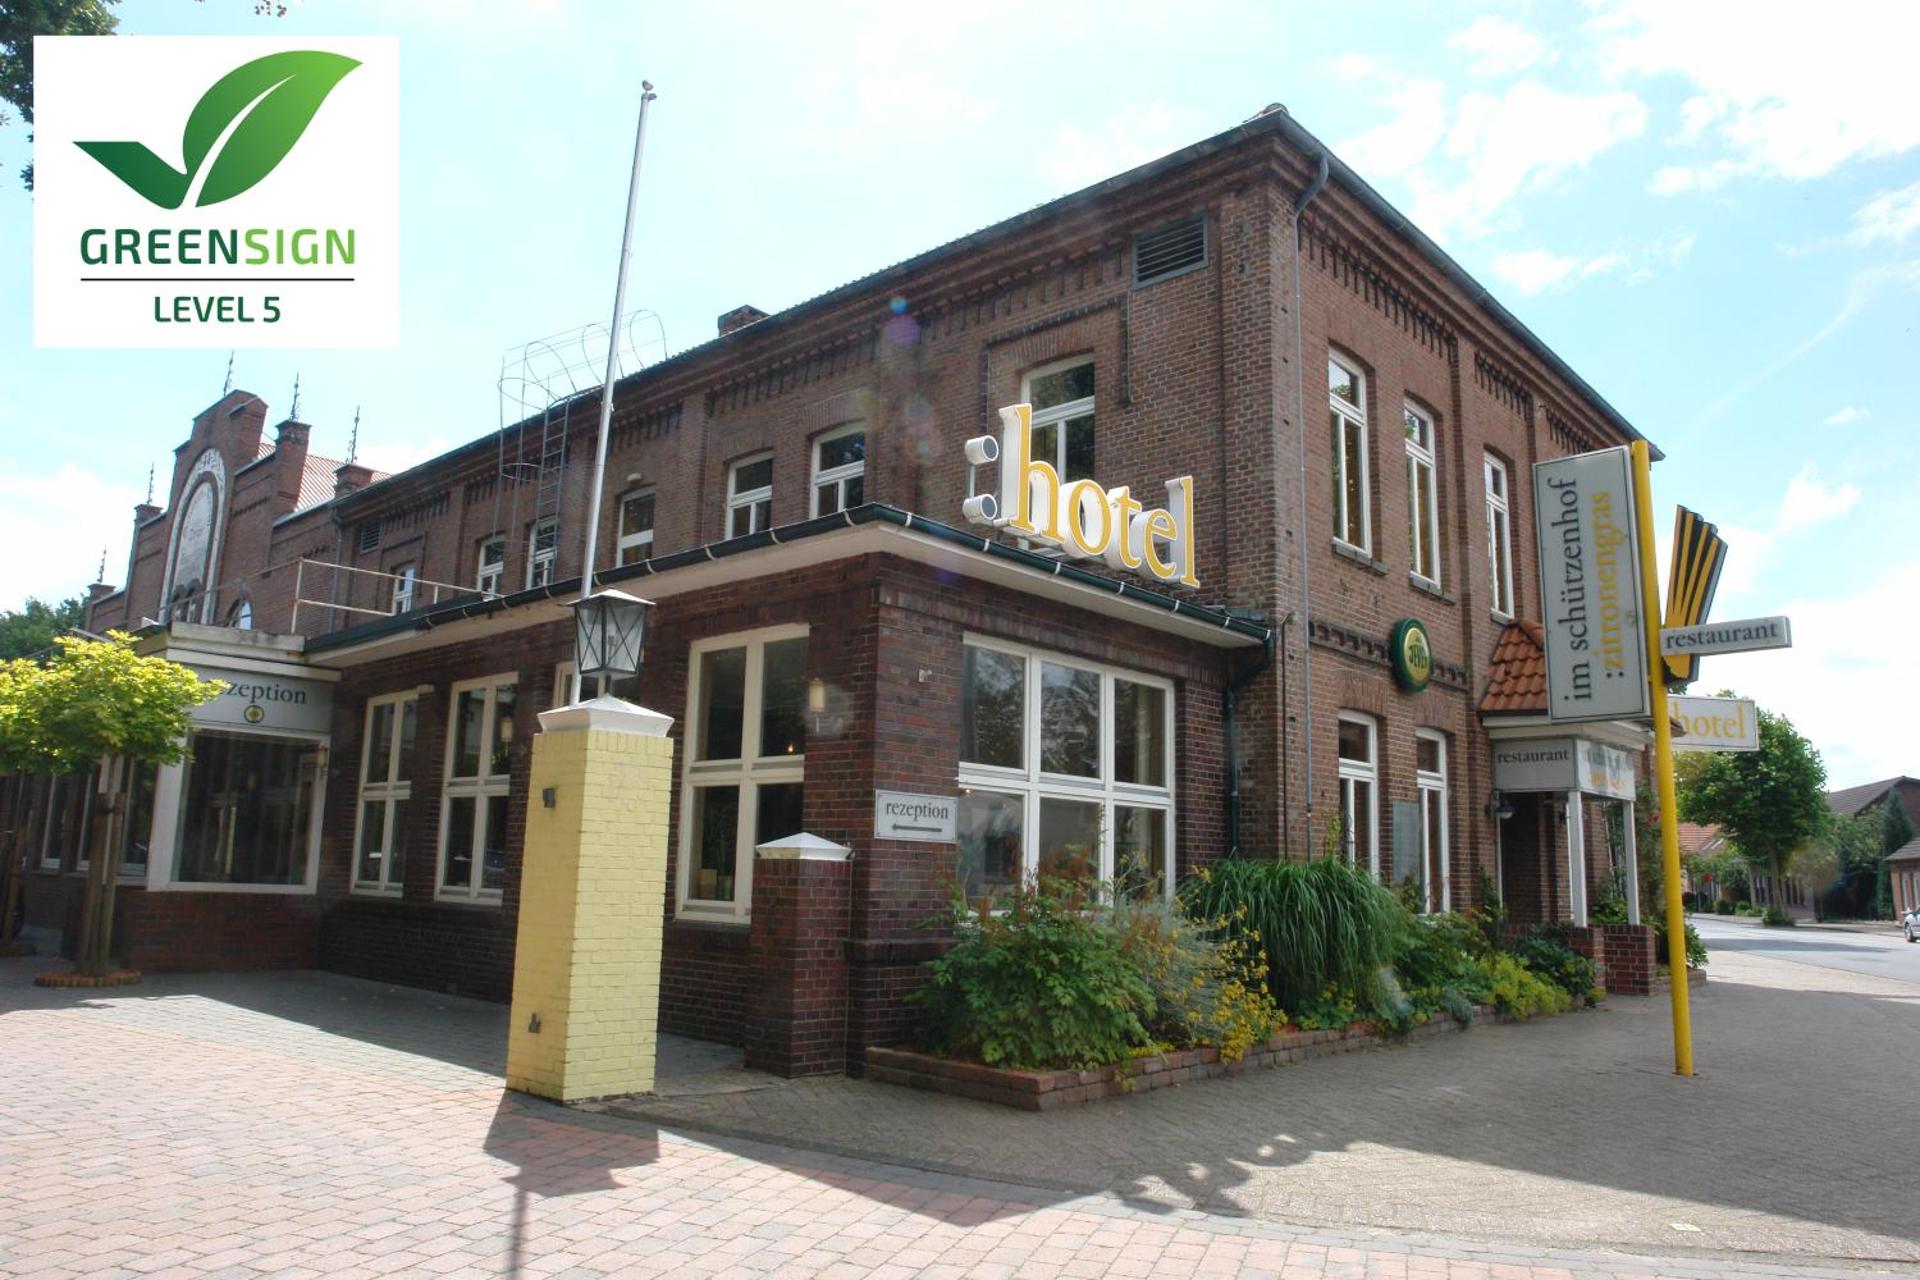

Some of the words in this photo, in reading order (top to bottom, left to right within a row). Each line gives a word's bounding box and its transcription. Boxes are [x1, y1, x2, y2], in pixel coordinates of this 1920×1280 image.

[1547, 477, 1588, 650] schützenhof
[1666, 622, 1779, 649] restaurant
[1564, 660, 1591, 701] im
[1498, 748, 1569, 764] restaurant
[886, 802, 949, 822] rezeption
